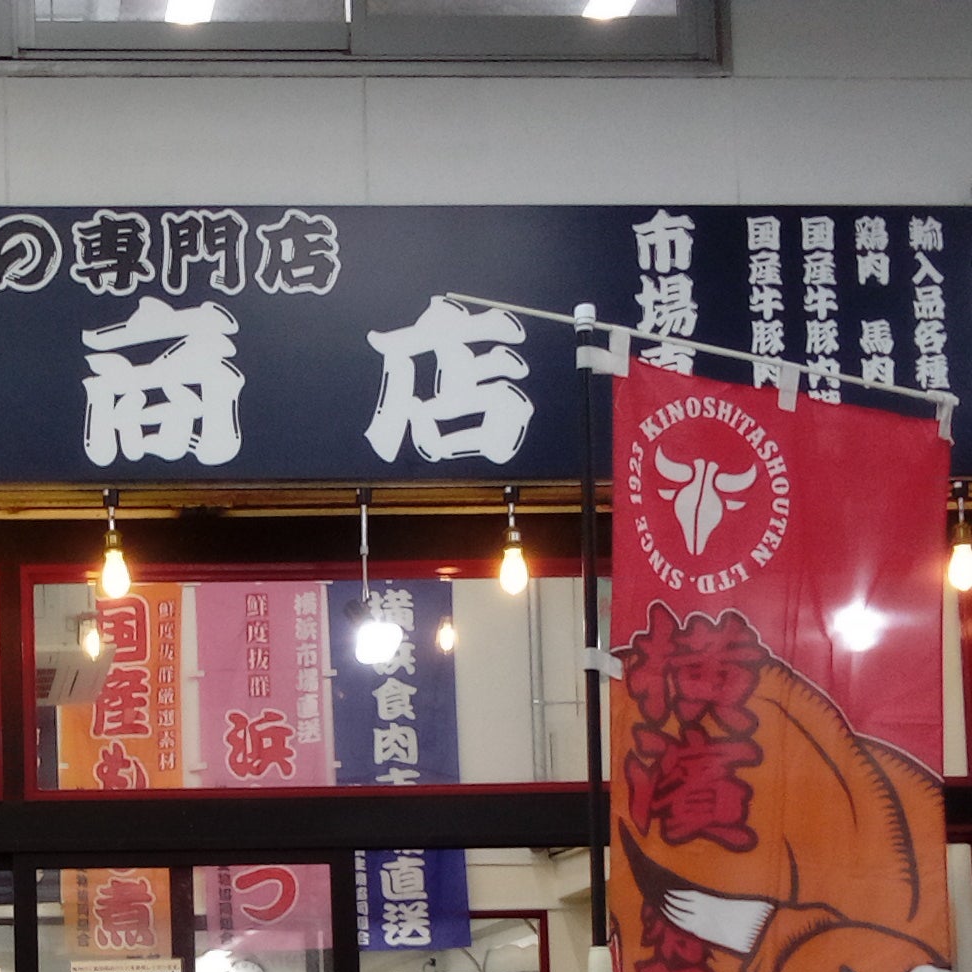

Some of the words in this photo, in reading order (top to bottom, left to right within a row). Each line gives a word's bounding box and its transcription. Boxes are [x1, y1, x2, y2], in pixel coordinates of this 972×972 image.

[908, 215, 951, 389] 輸入品各種
[637, 395, 790, 569] KINOSHITASHOUTEN
[245, 593, 271, 697] 鮮度抜群
